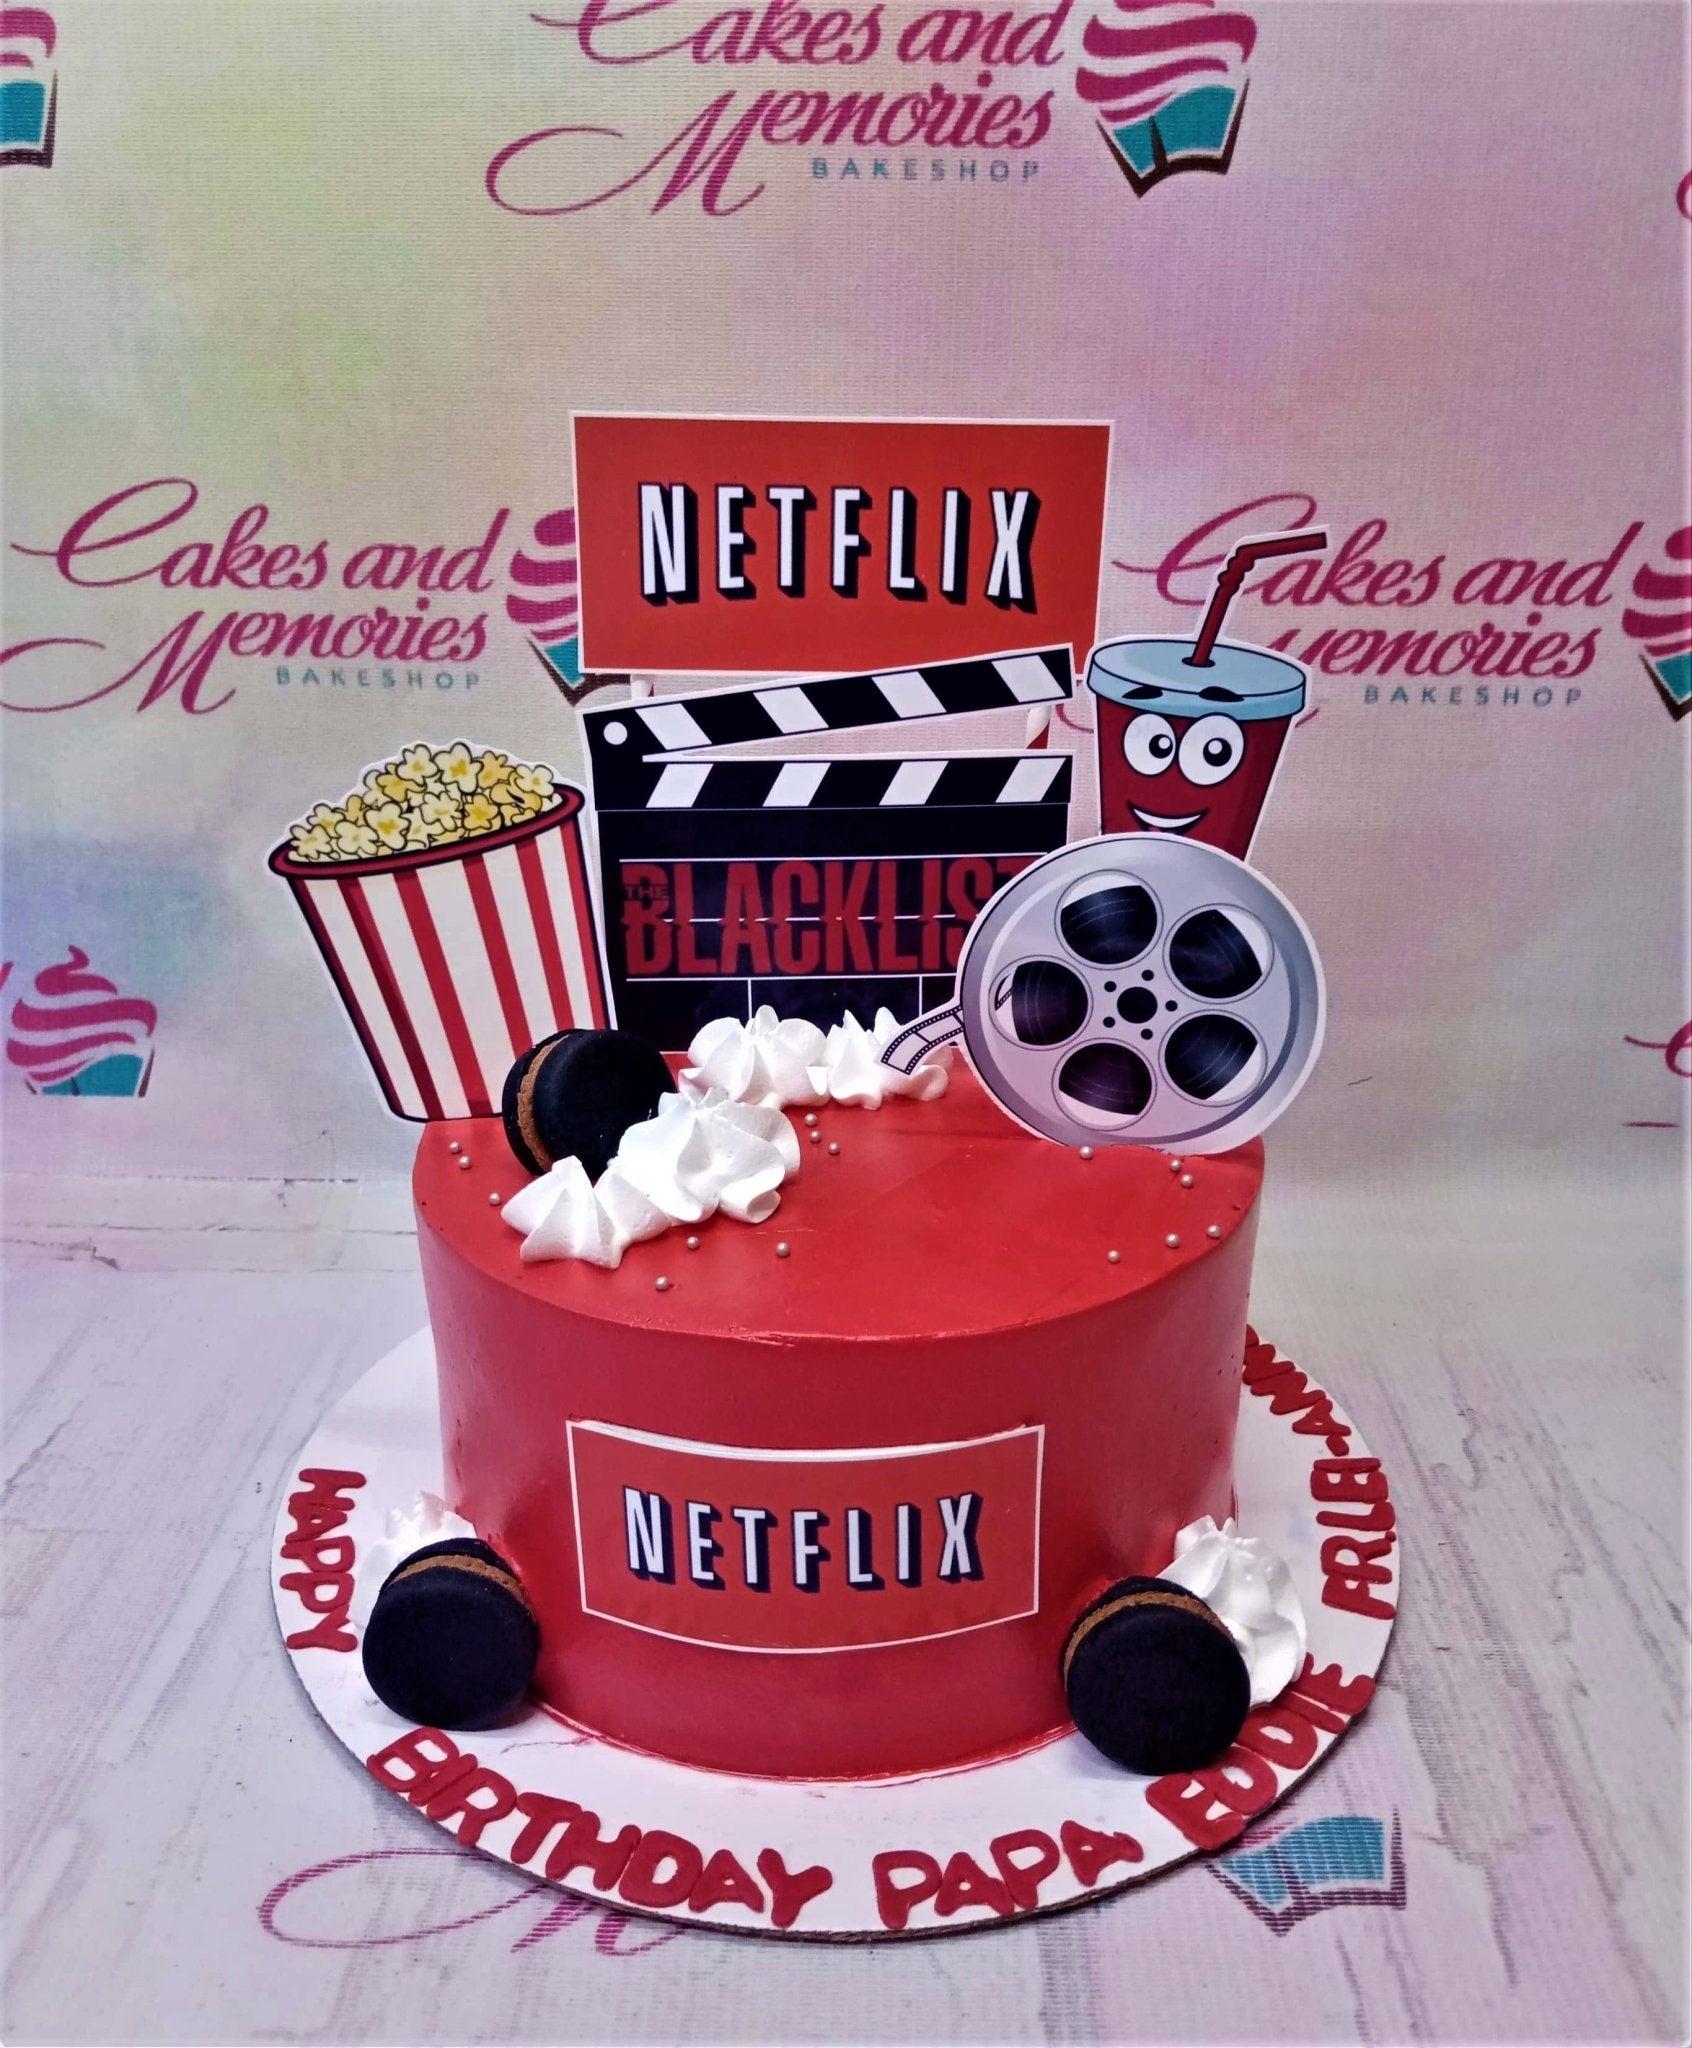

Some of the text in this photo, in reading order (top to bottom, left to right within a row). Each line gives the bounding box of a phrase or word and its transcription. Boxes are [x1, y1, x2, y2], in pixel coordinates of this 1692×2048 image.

[530, 0, 1078, 65] Cakes and
[485, 71, 1054, 216] Memories
[811, 157, 1041, 182] BAKESHOP
[10, 477, 510, 592] Cakes and
[638, 482, 1041, 614] NETFLIX
[1112, 493, 1645, 608] Cakes and
[0, 597, 487, 714] Memories
[276, 667, 480, 689] BAKESHOP
[1364, 685, 1581, 707] BAKESHOP
[279, 1467, 366, 1653] HAPPY
[624, 1485, 984, 1593] NETFLIX
[366, 1726, 833, 1928] BIRTHDAY
[872, 1820, 1144, 1929] PAPA
[1145, 1651, 1376, 1850] EDDIE
